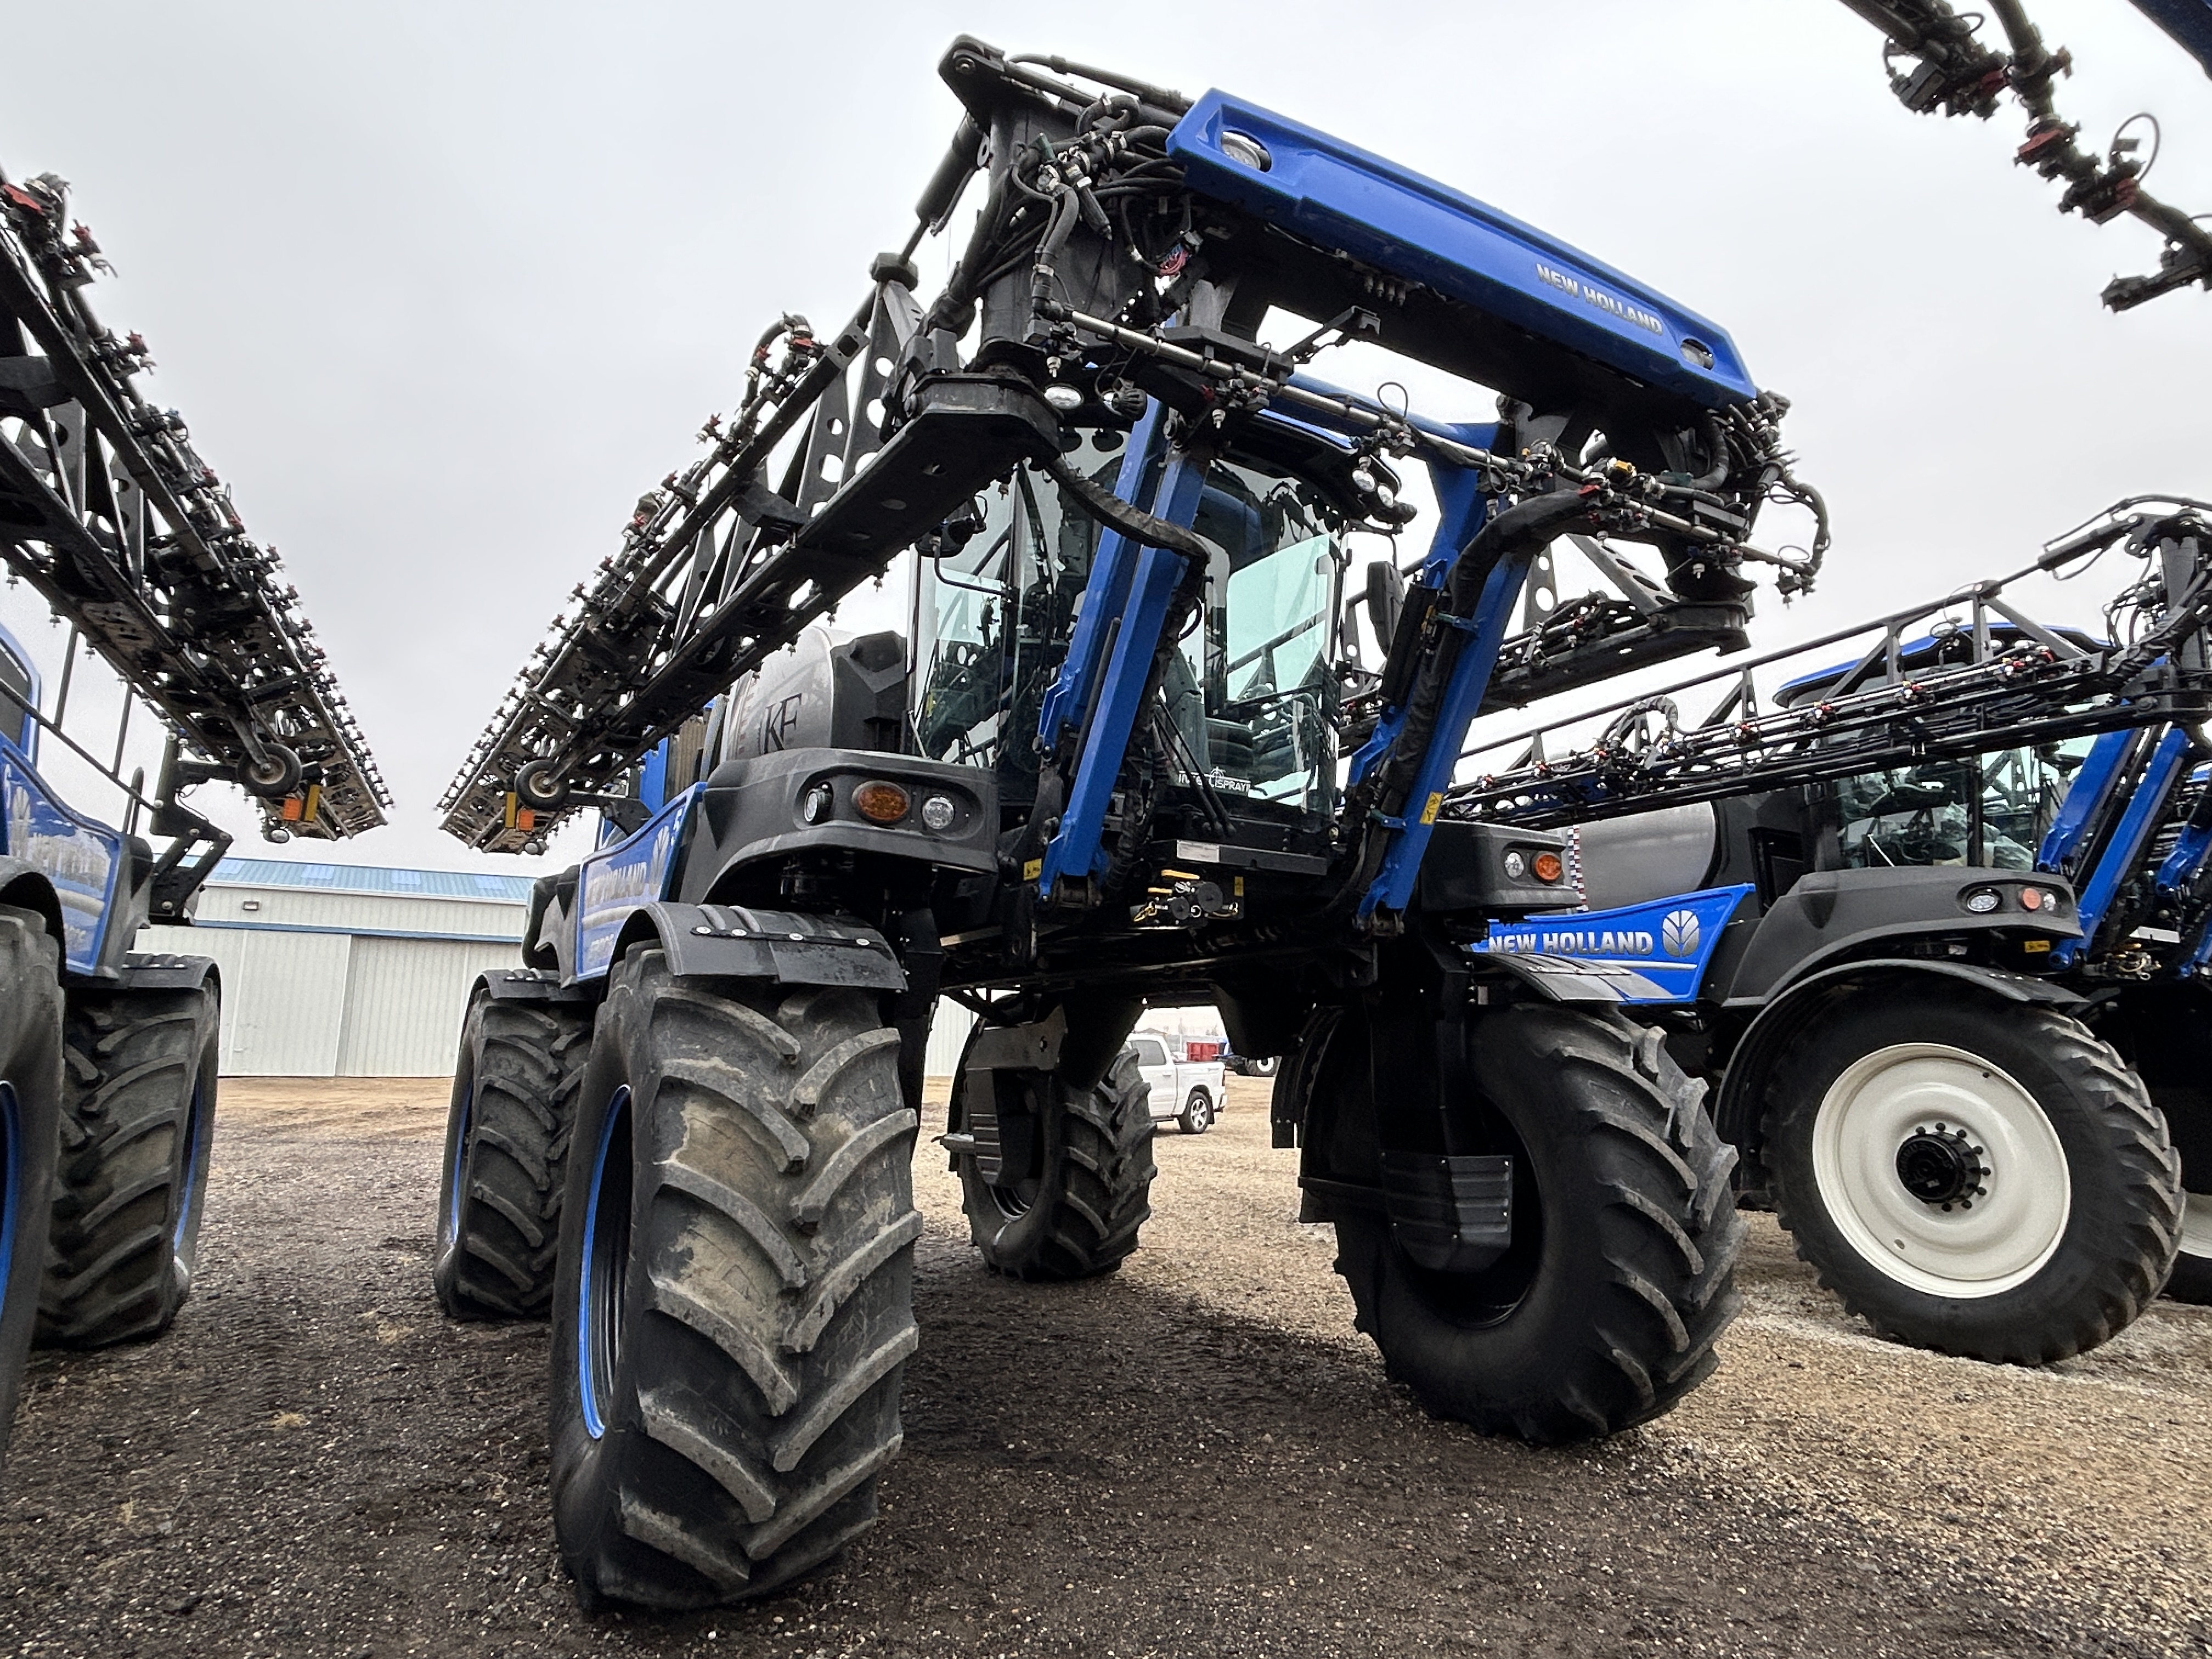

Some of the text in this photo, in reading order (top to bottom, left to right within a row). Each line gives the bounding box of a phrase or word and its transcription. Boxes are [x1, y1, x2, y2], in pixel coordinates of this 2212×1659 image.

[1536, 263, 1663, 336] NEW HOLLAND
[1488, 932, 1654, 955] NEW HOLLAND
